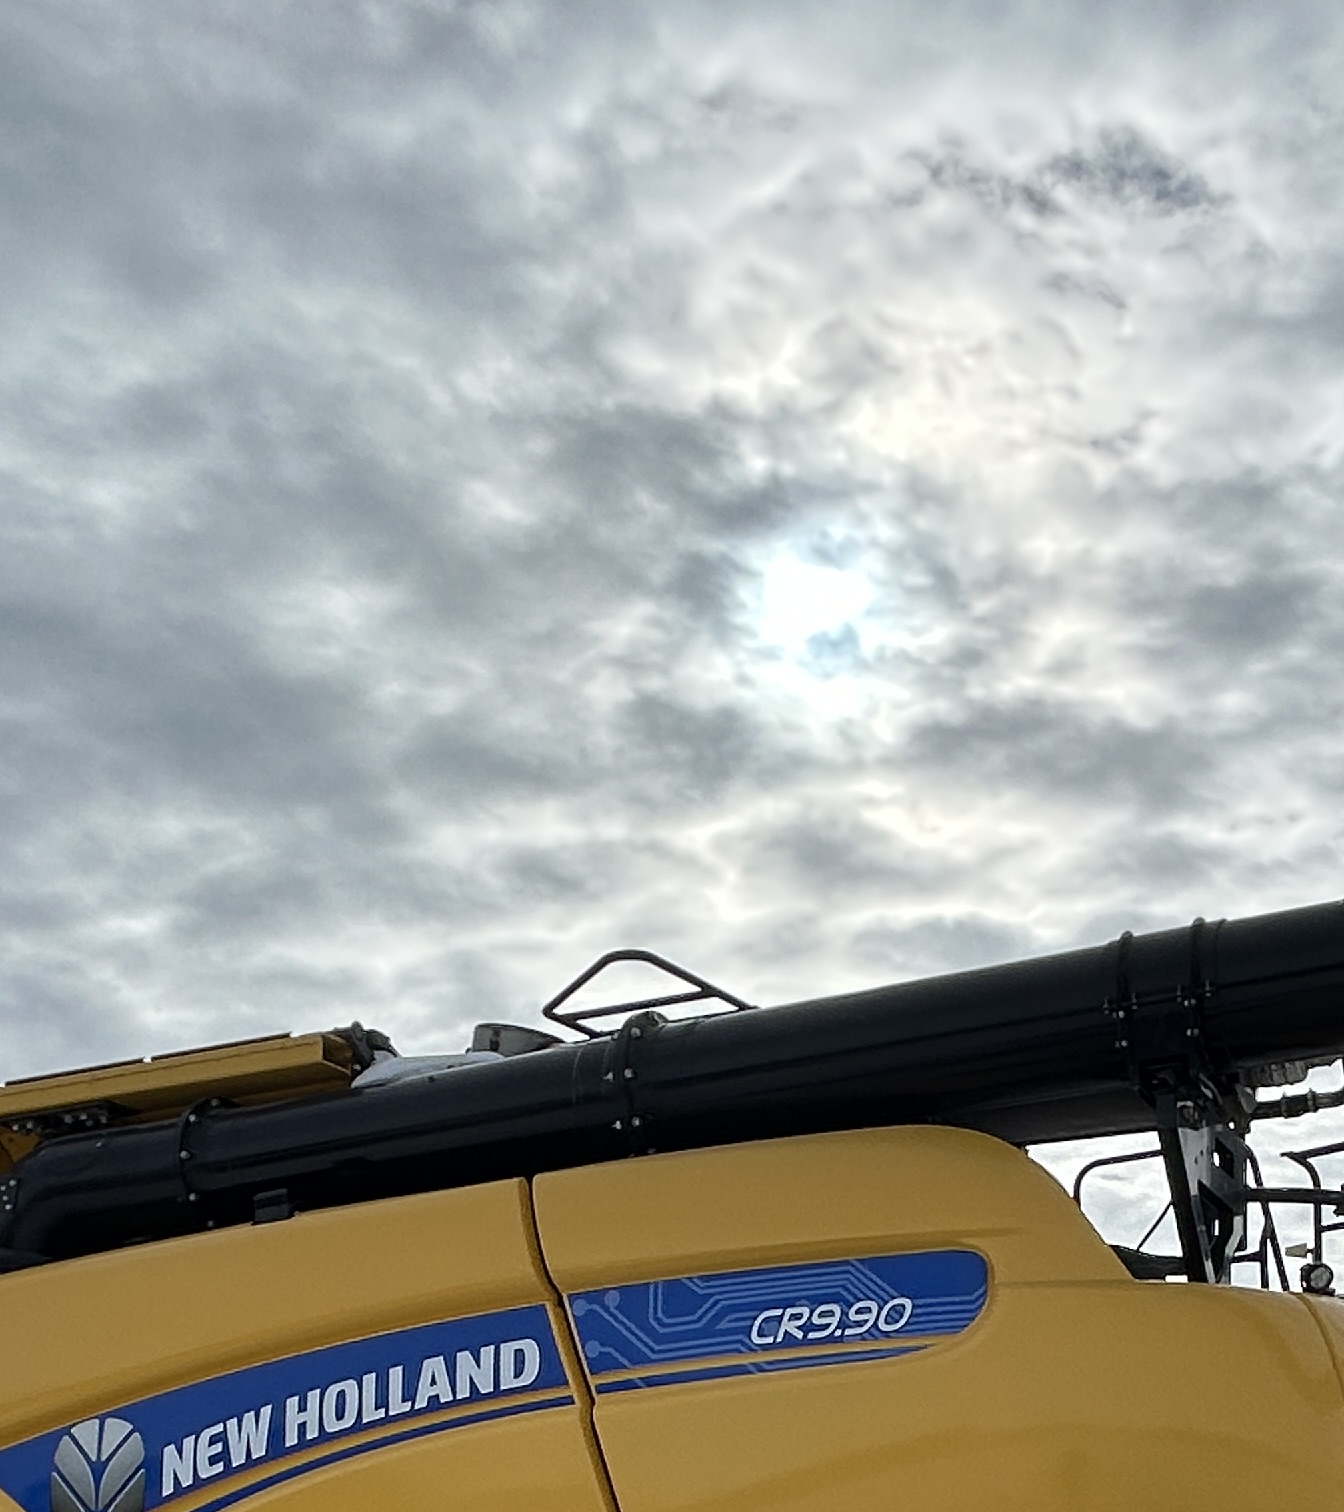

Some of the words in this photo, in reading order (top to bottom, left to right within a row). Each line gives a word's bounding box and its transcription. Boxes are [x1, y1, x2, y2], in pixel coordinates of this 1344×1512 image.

[750, 1297, 914, 1345] CR9.90
[162, 1403, 273, 1497] NEW
[284, 1338, 540, 1448] HOLLAND
